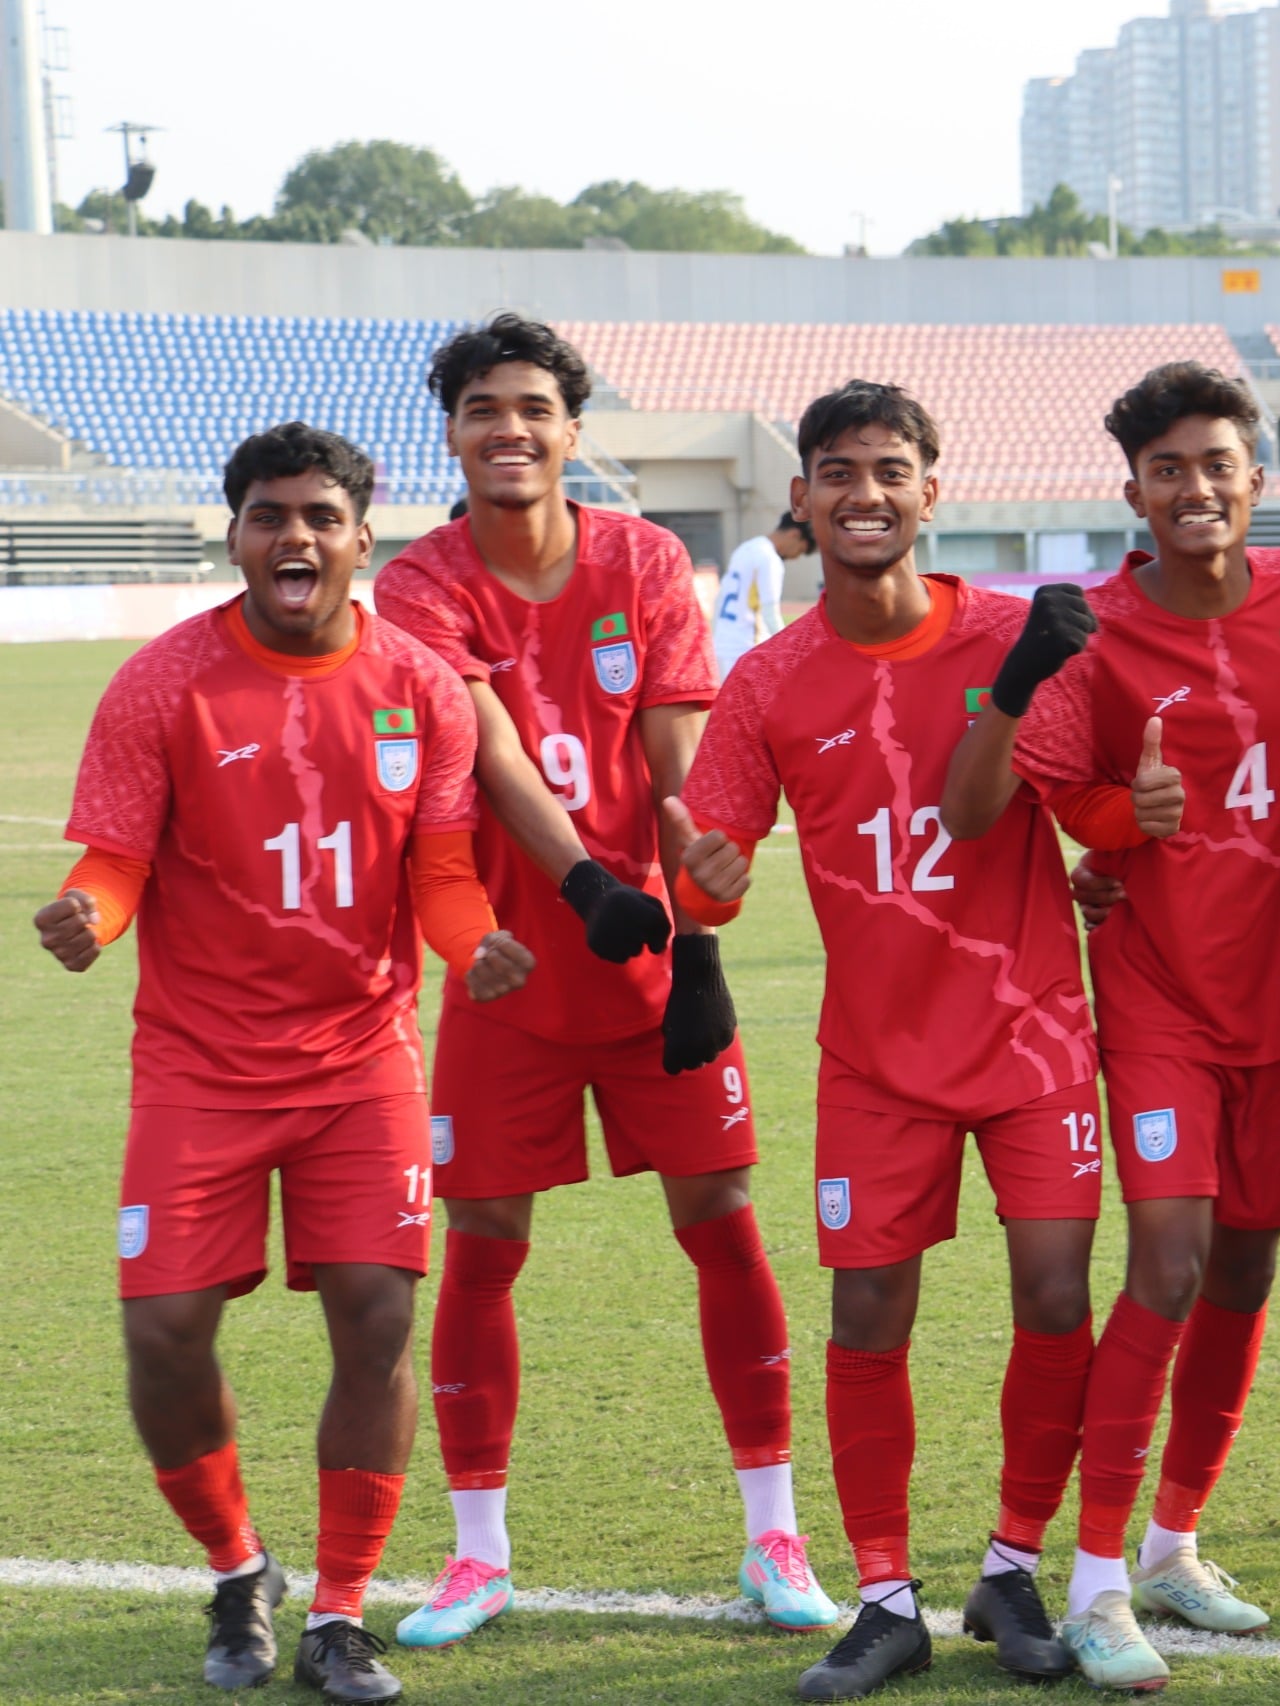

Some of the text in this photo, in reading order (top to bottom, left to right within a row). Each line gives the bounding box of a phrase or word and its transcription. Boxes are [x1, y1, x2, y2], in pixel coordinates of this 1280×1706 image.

[540, 733, 591, 812] 9
[1224, 742, 1275, 821] 4
[264, 821, 354, 909] 11
[857, 806, 954, 893] 12
[721, 1065, 745, 1105] 9
[1061, 1110, 1101, 1153] 12
[402, 1163, 433, 1208] 11
